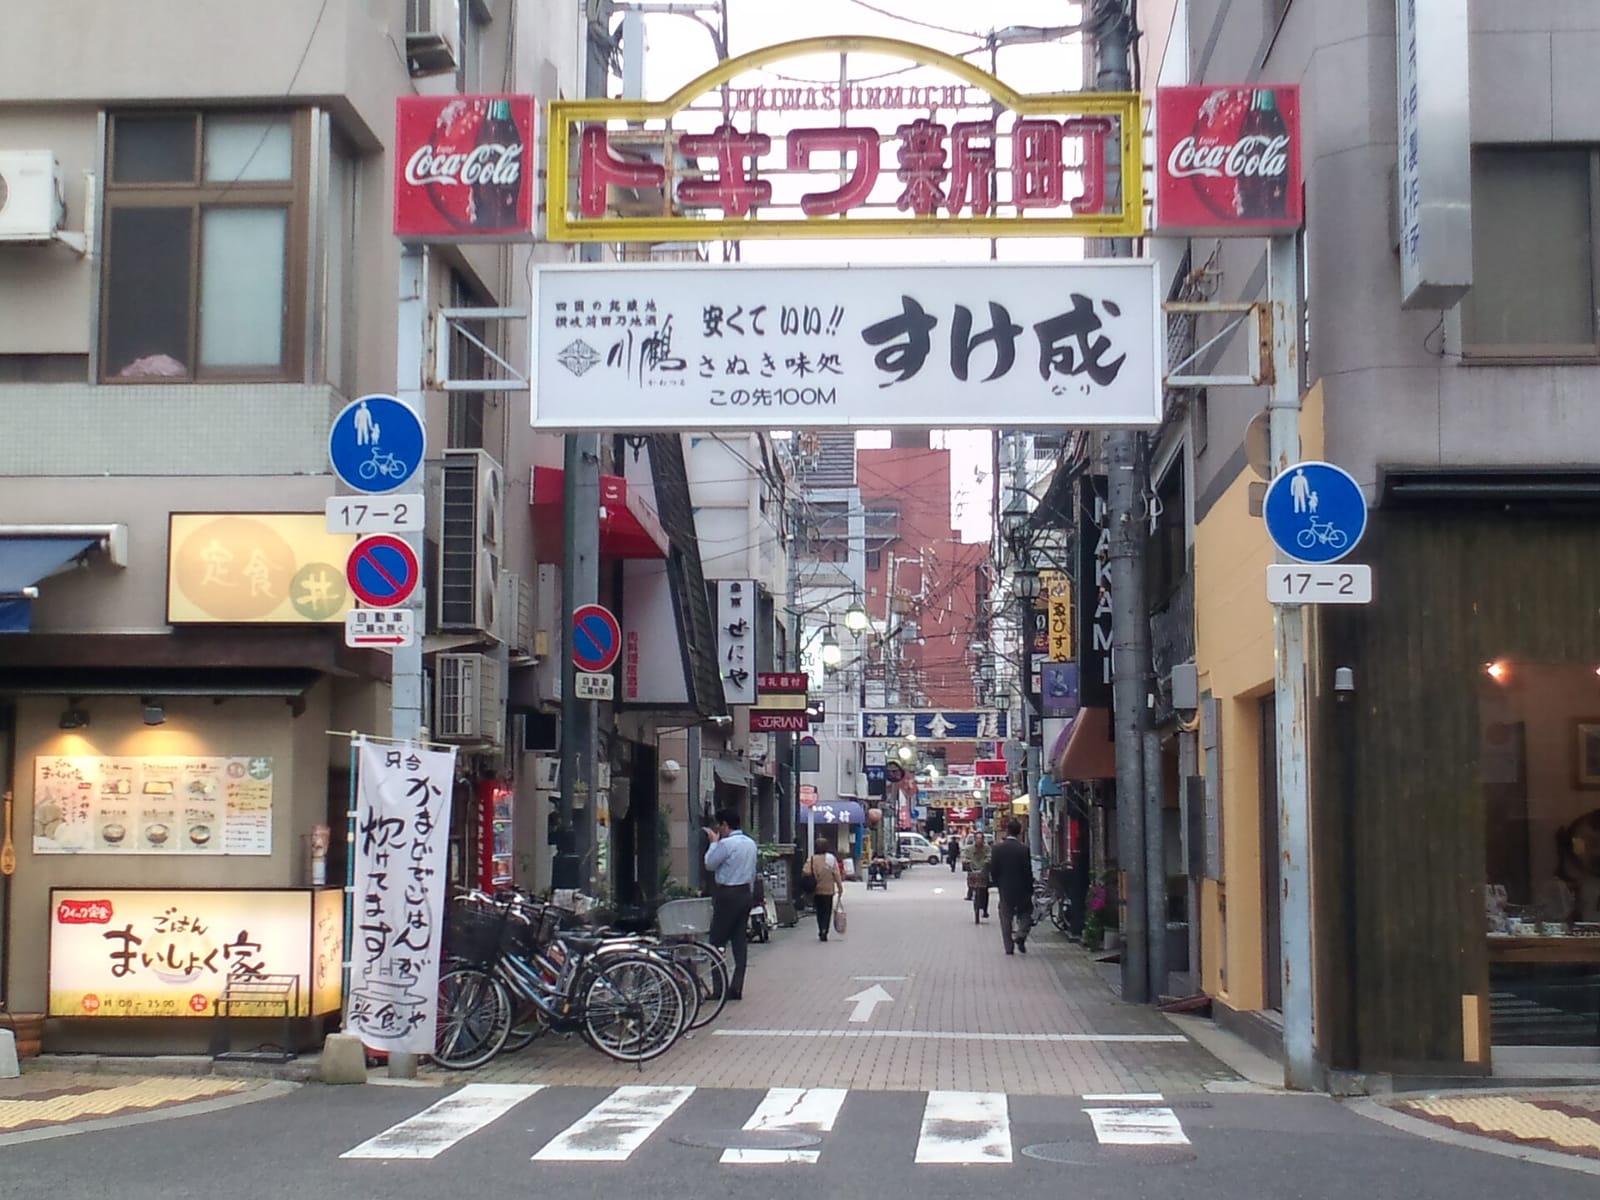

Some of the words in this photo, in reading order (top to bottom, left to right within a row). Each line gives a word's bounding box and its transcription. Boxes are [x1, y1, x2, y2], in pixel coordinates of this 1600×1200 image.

[405, 143, 523, 186] Coca-Cola
[581, 117, 1111, 217] トキワ新町
[1168, 135, 1290, 178] Coca-Cola
[703, 304, 767, 338] 安くて
[861, 293, 1127, 388] すけ成
[699, 350, 844, 379] さぬき味処
[710, 387, 837, 406] この先100M
[201, 539, 280, 600] 定食
[1283, 573, 1354, 595] 17-2
[356, 611, 403, 623] 自動車
[385, 750, 422, 771] 只今
[153, 906, 208, 934] ごはん
[103, 923, 271, 982] まいしょく家
